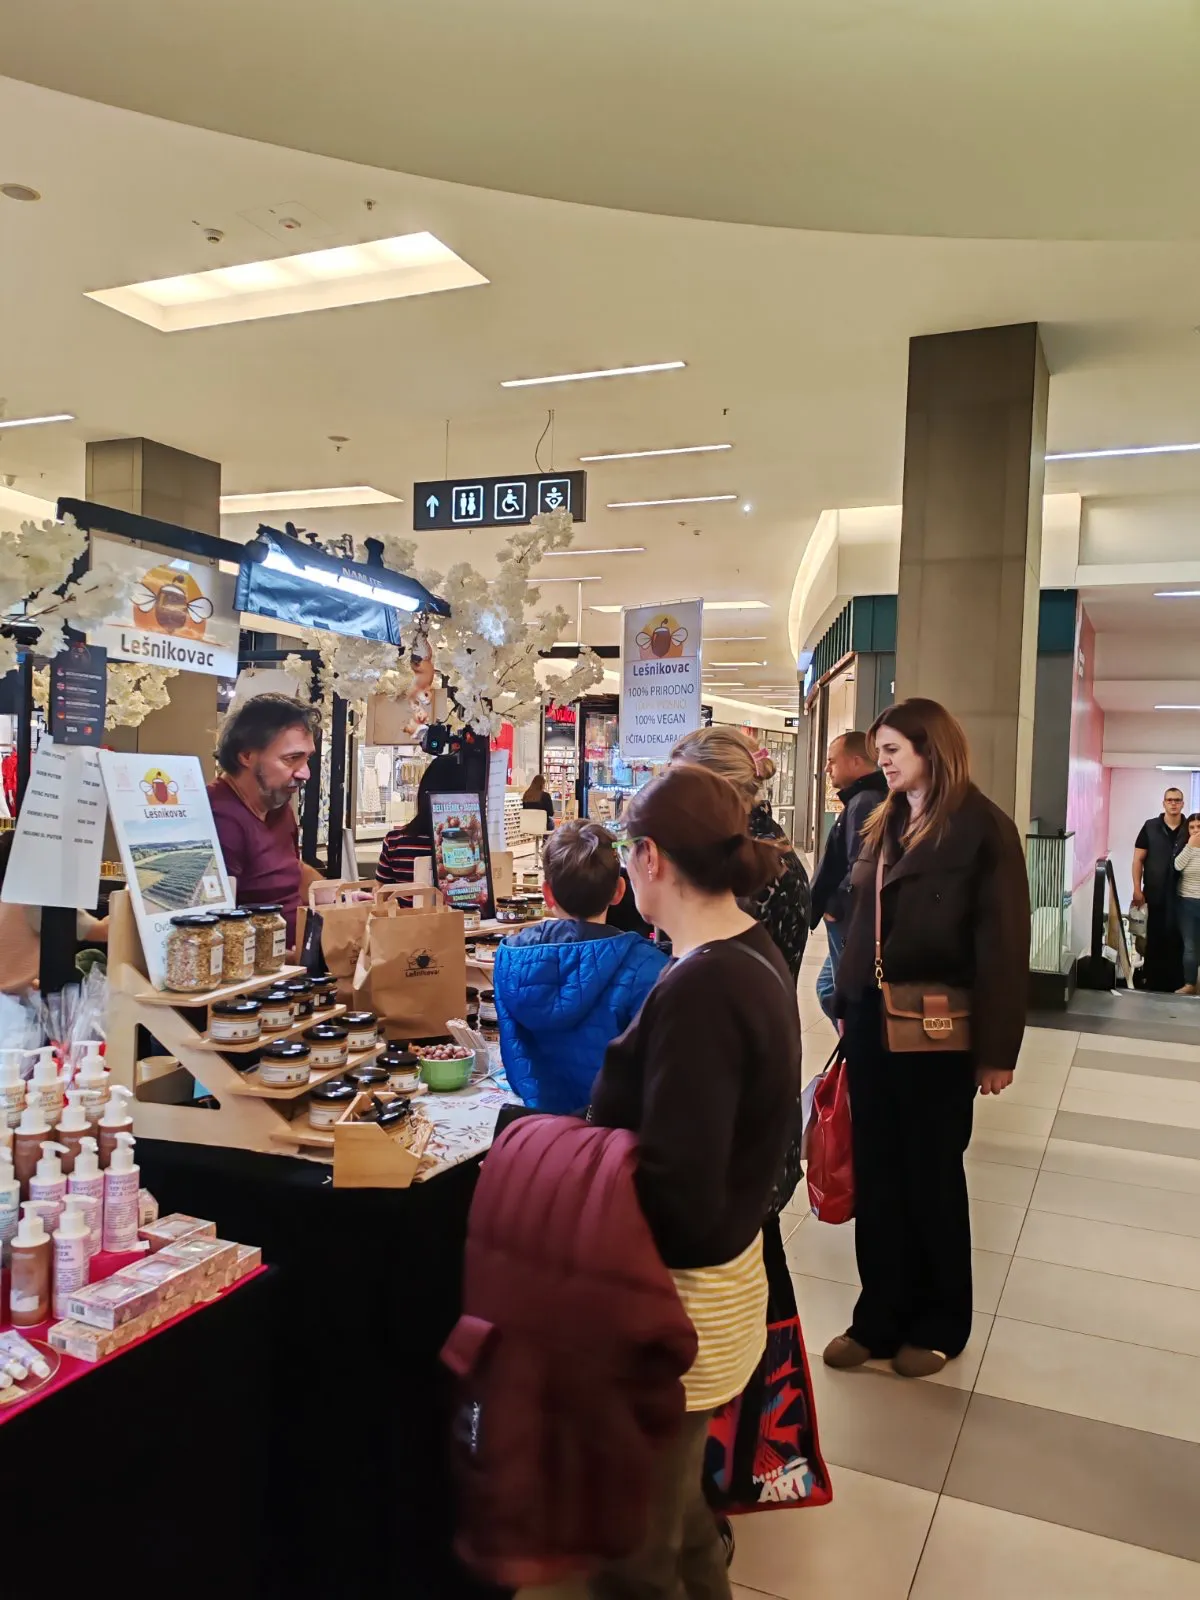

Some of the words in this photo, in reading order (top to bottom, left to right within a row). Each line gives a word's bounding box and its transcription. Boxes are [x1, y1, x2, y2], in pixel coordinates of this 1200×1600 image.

[121, 634, 214, 666] Lešnikovac
[633, 662, 690, 677] Lešnikovac
[629, 687, 649, 697] 100%
[650, 683, 695, 696] PRIRODNO
[635, 715, 655, 725] 100%
[657, 713, 686, 725] VEGAN
[144, 808, 187, 819] Lešnikovac
[752, 1466, 784, 1485] MORE
[757, 1464, 809, 1503] ART
